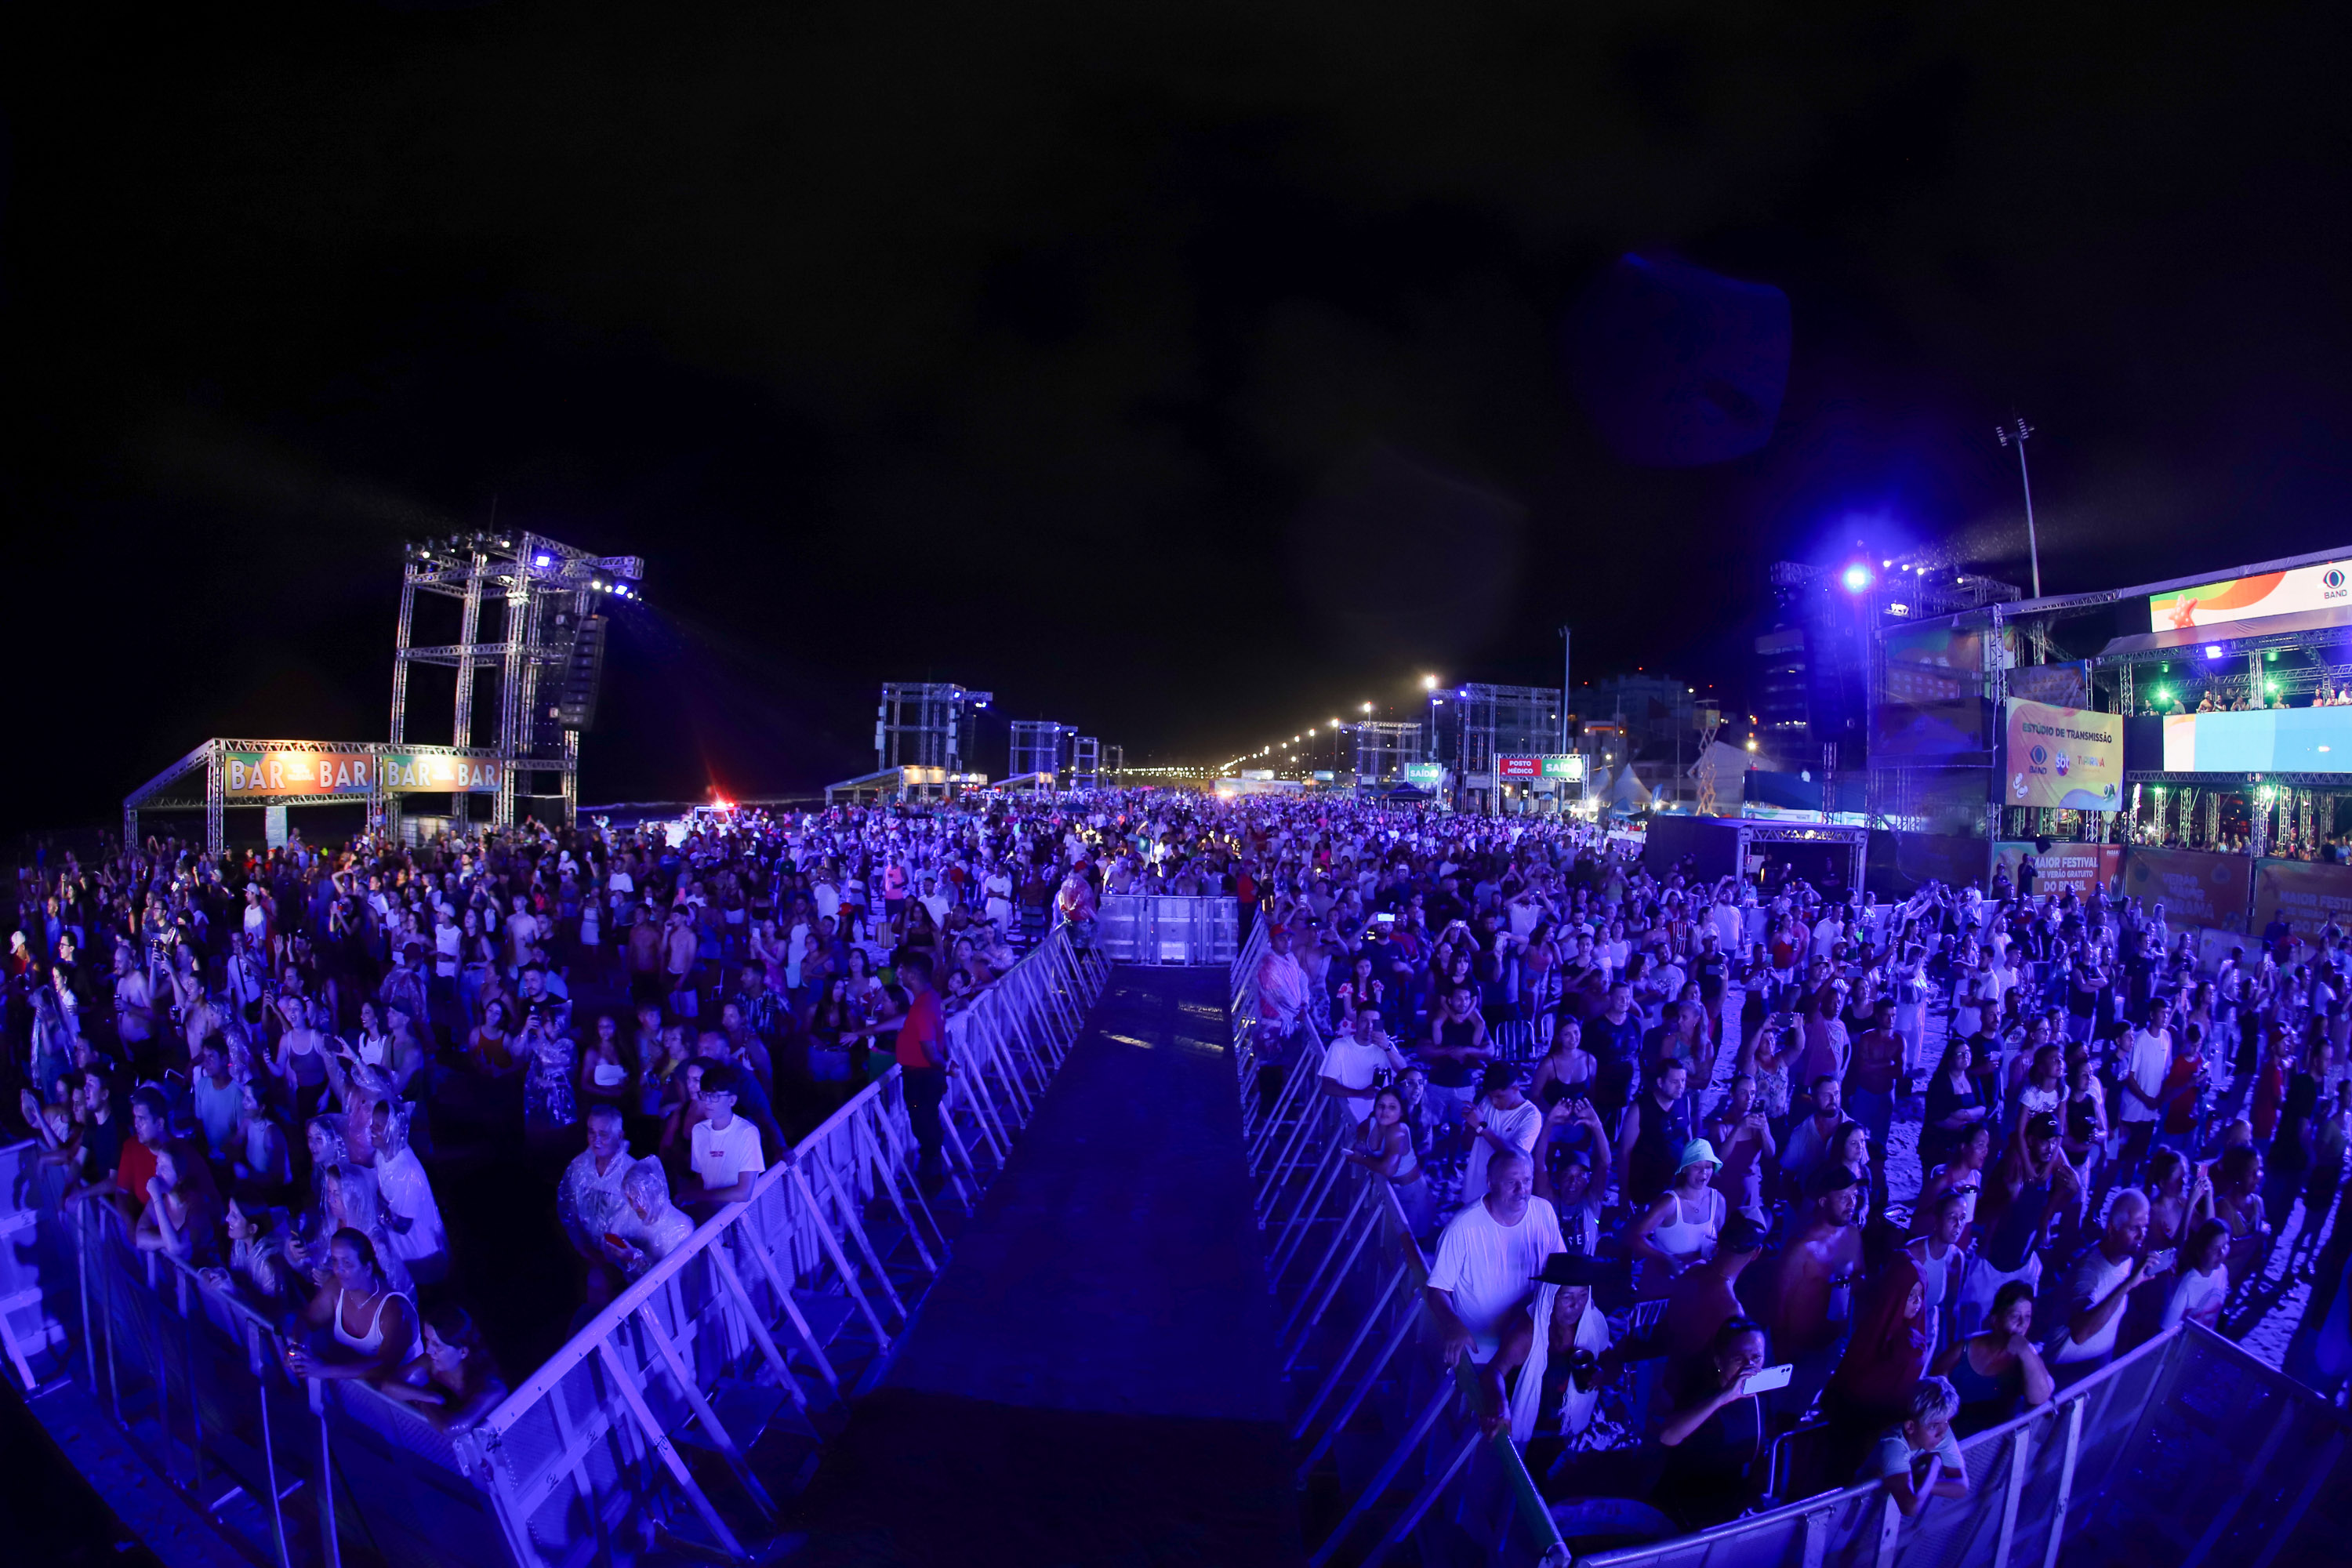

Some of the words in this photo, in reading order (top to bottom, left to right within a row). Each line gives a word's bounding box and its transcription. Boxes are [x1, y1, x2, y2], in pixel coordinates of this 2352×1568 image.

[2324, 589, 2347, 600] BAND
[2023, 722, 2054, 737] ESTÚDIO
[2056, 728, 2065, 738] DE
[2067, 728, 2112, 743] TRANSMISSÃO
[1545, 762, 1577, 772] SAÍD
[2029, 765, 2047, 775] BAND
[2056, 752, 2070, 768] sbt
[230, 759, 286, 790] BAR
[319, 759, 368, 789] BAR
[387, 761, 431, 786] BAR
[458, 763, 495, 787] BAR
[2063, 857, 2099, 868] FESTIVAL
[2047, 868, 2066, 878] VERÃO
[2044, 882, 2057, 892] DO
[2280, 891, 2318, 906] MAIOR
